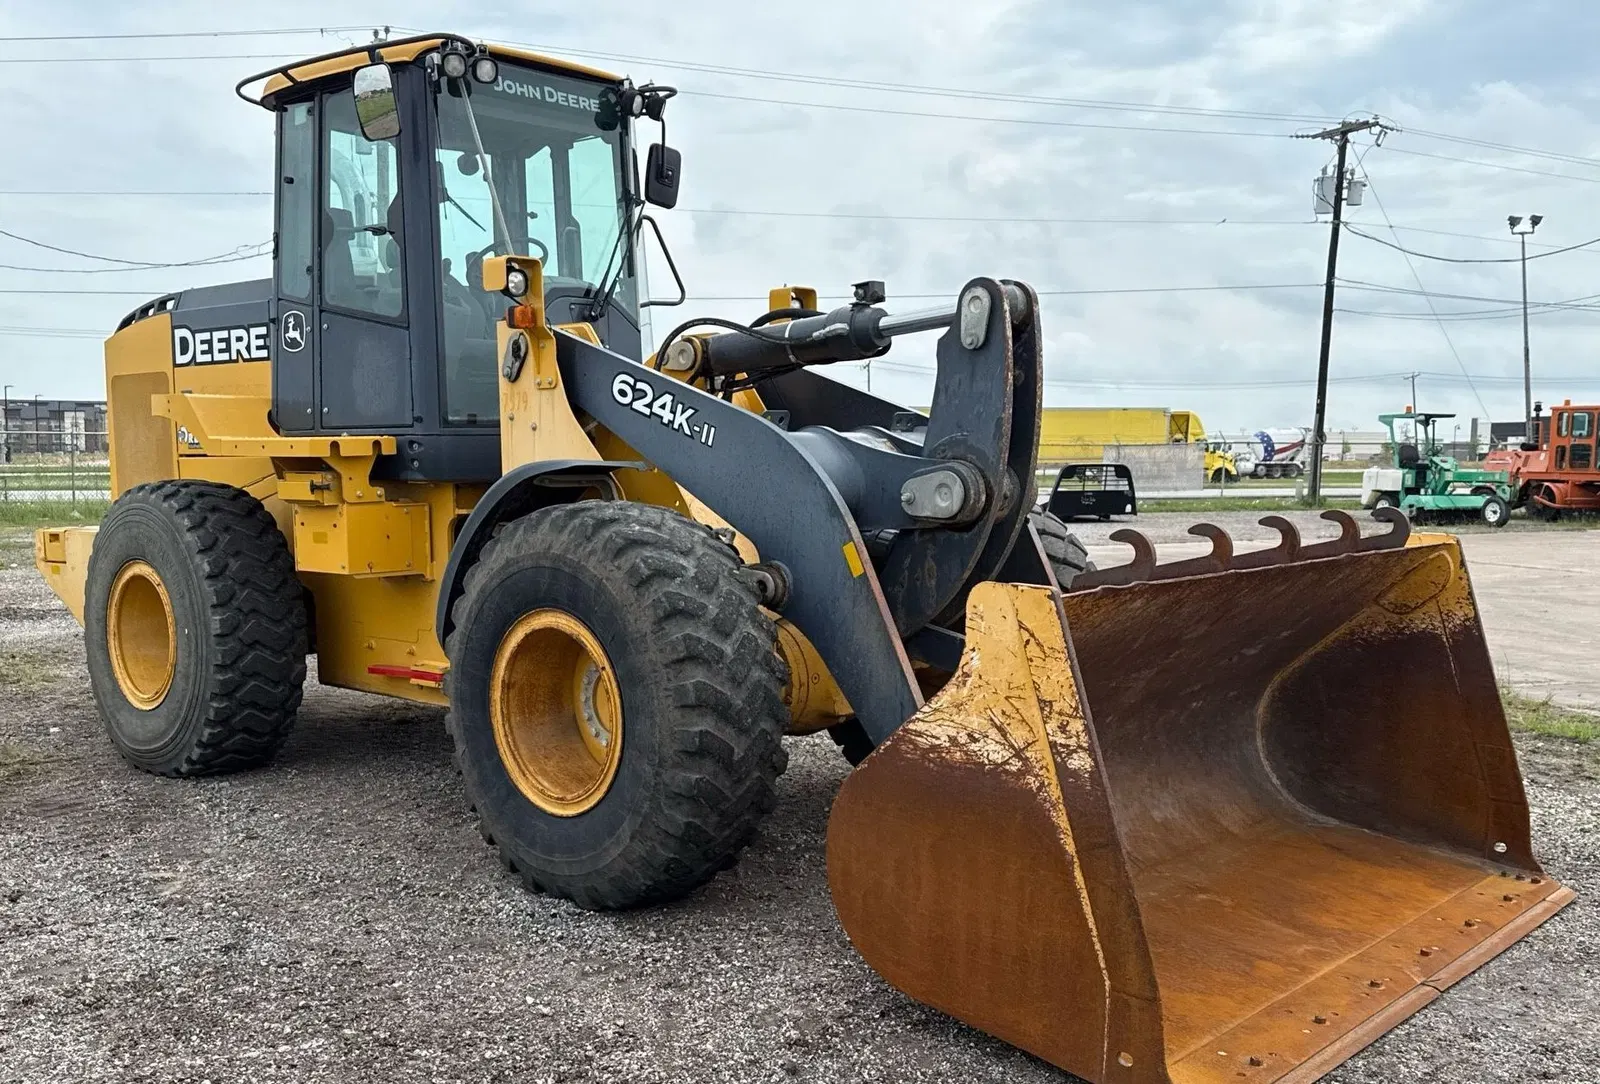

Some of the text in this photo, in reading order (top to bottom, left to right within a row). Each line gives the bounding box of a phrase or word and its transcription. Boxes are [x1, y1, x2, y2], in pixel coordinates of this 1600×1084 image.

[493, 75, 601, 112] JOHN DEERE
[173, 325, 269, 366] DEERE
[610, 371, 717, 447] 624K-II
